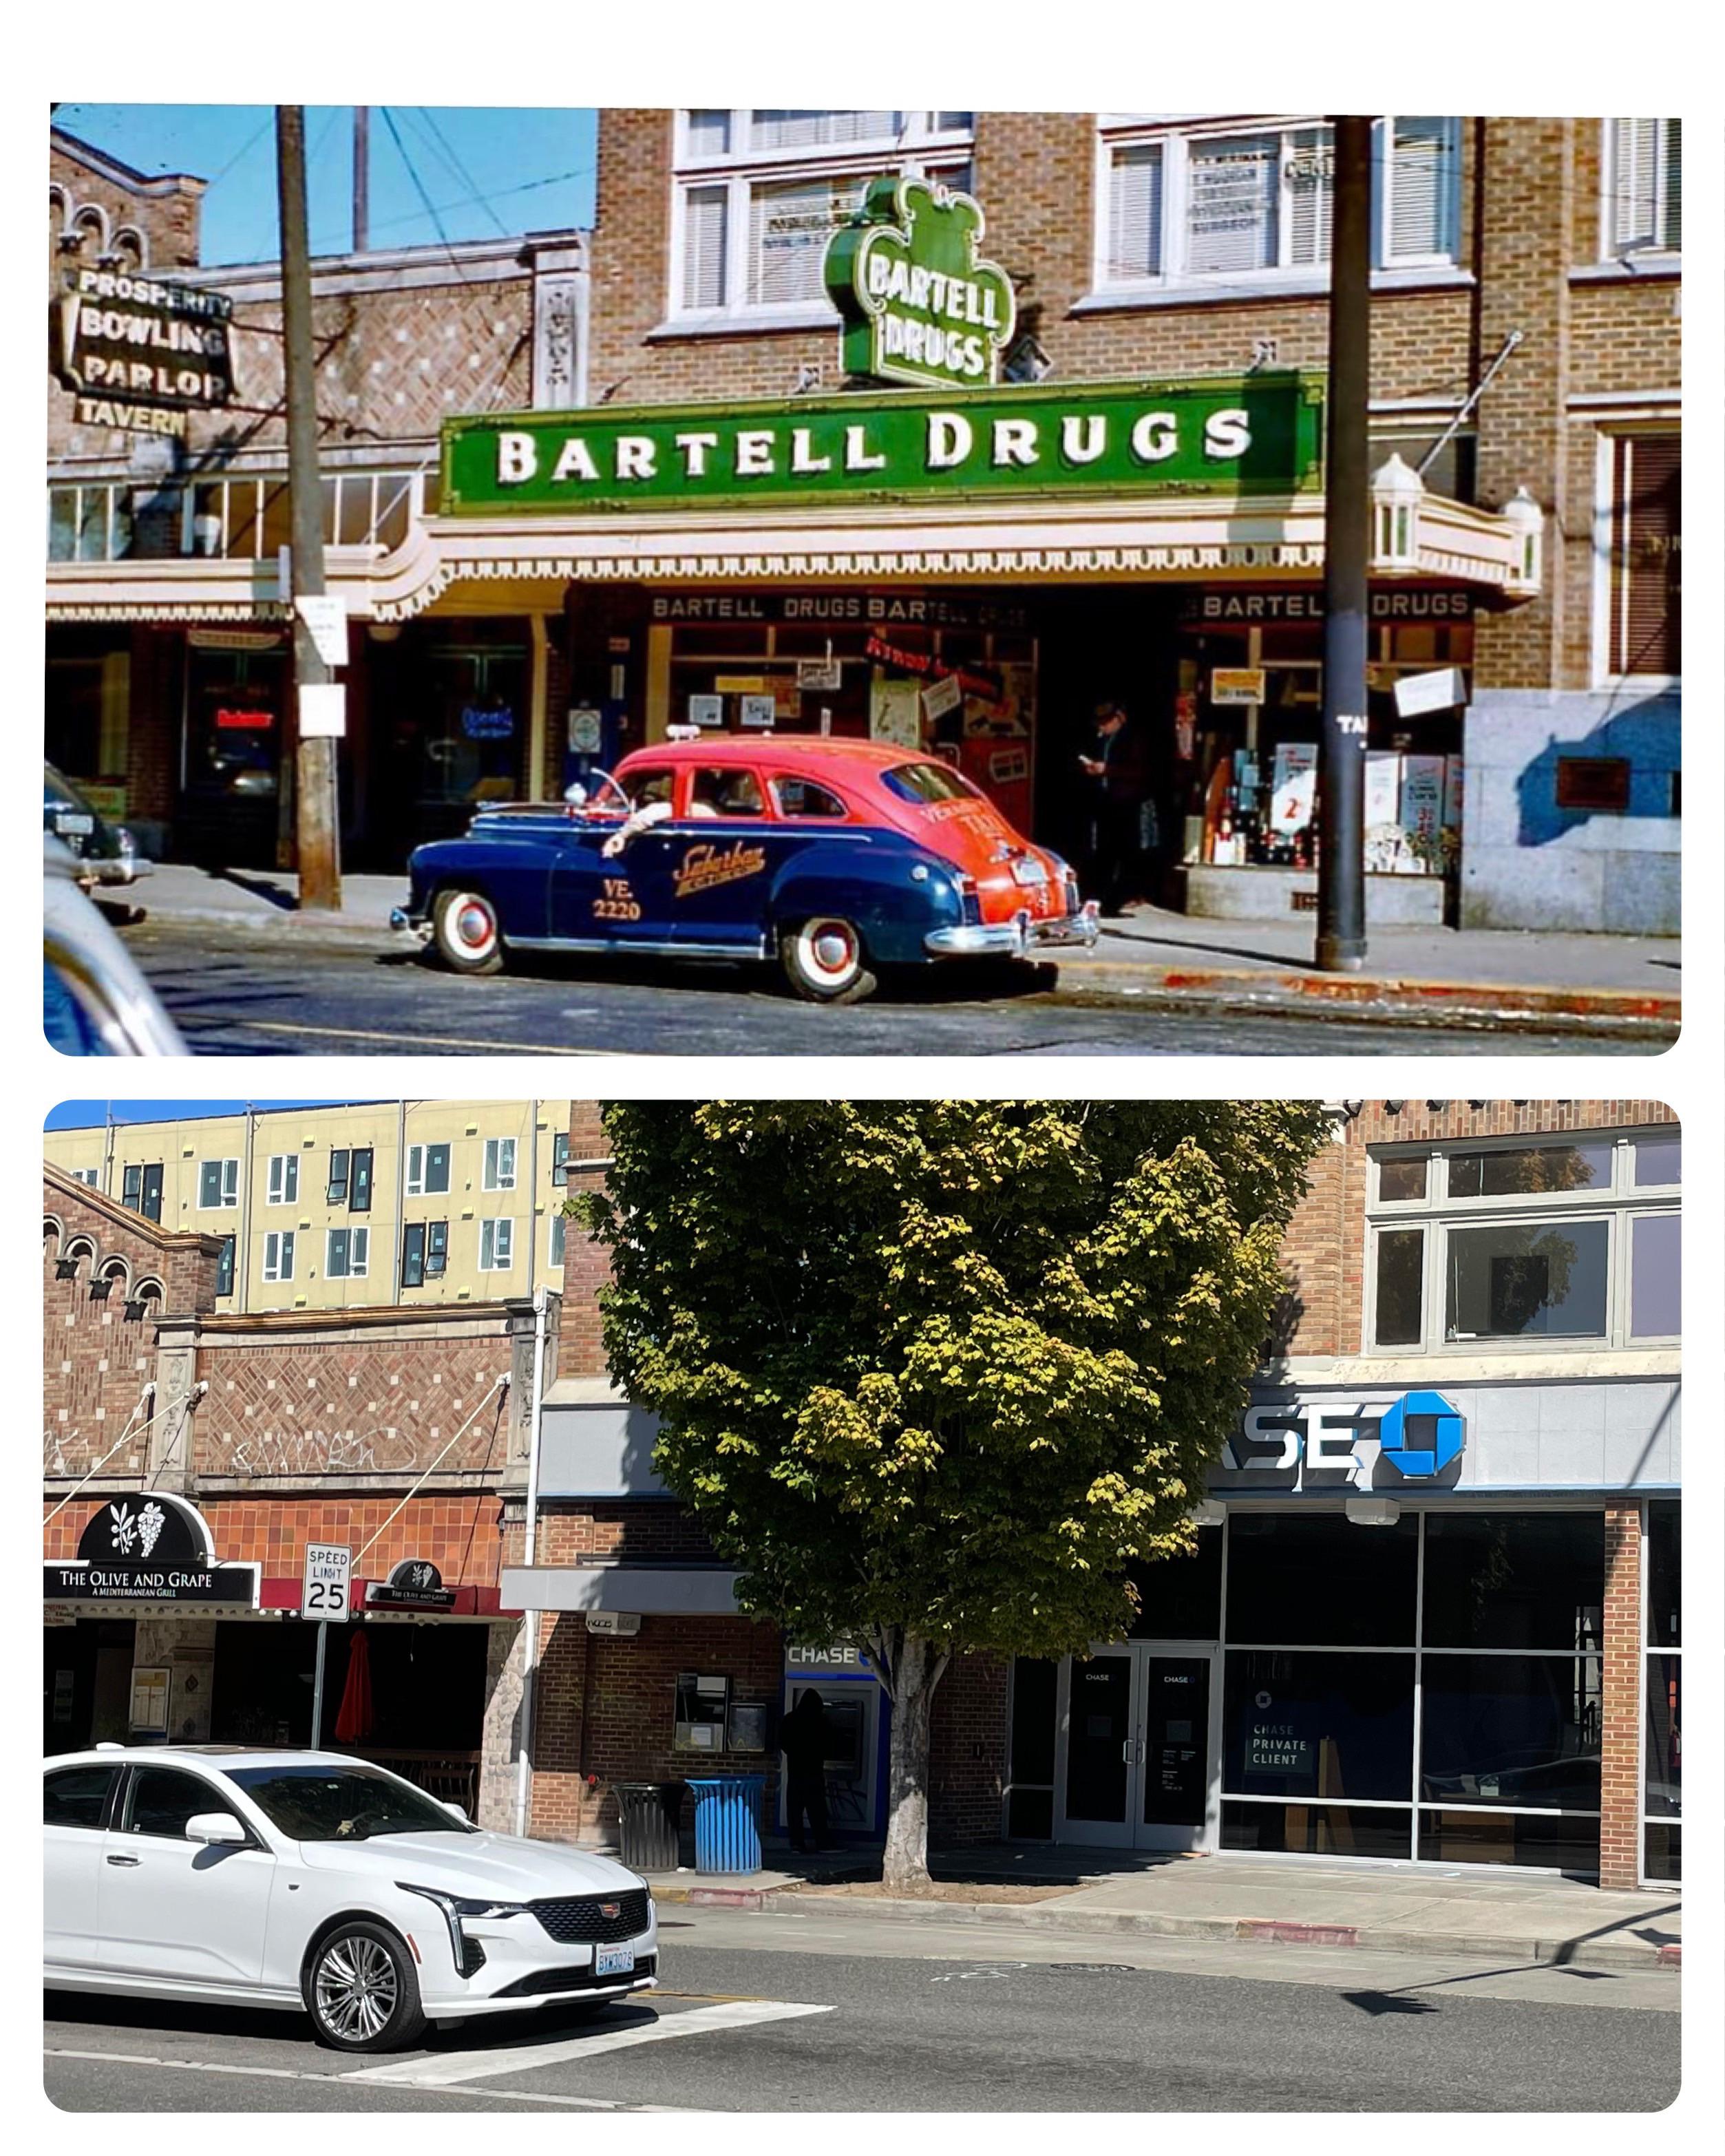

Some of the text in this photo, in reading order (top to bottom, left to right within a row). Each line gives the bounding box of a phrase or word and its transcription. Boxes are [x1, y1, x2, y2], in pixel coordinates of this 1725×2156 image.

[79, 271, 232, 317] PROSPERITY
[869, 253, 999, 328] BARTELL
[81, 307, 224, 355] BOWLING
[885, 313, 985, 375] DRUGS
[83, 356, 226, 400] PARLOR
[78, 399, 186, 435] TAVERN
[497, 410, 1251, 483] BARTELL DRUGS
[654, 598, 860, 617] BARTELL DRUGS
[1204, 594, 1468, 616] BARTEL DRUGS
[593, 899, 641, 920] 2220
[309, 1550, 348, 1565] SPEED
[59, 1570, 212, 1588] THE OLIVE AND GRAPE
[313, 1566, 342, 1580] LIMIT
[99, 1588, 156, 1597] MEDITERRANEAN
[156, 1587, 176, 1597] GRILL
[308, 1582, 343, 1609] 25
[788, 1647, 855, 1663] CHASE
[1253, 1724, 1294, 1735] CHASE
[1253, 1738, 1306, 1751] PRIVATE
[1253, 1753, 1297, 1765] CLIENT
